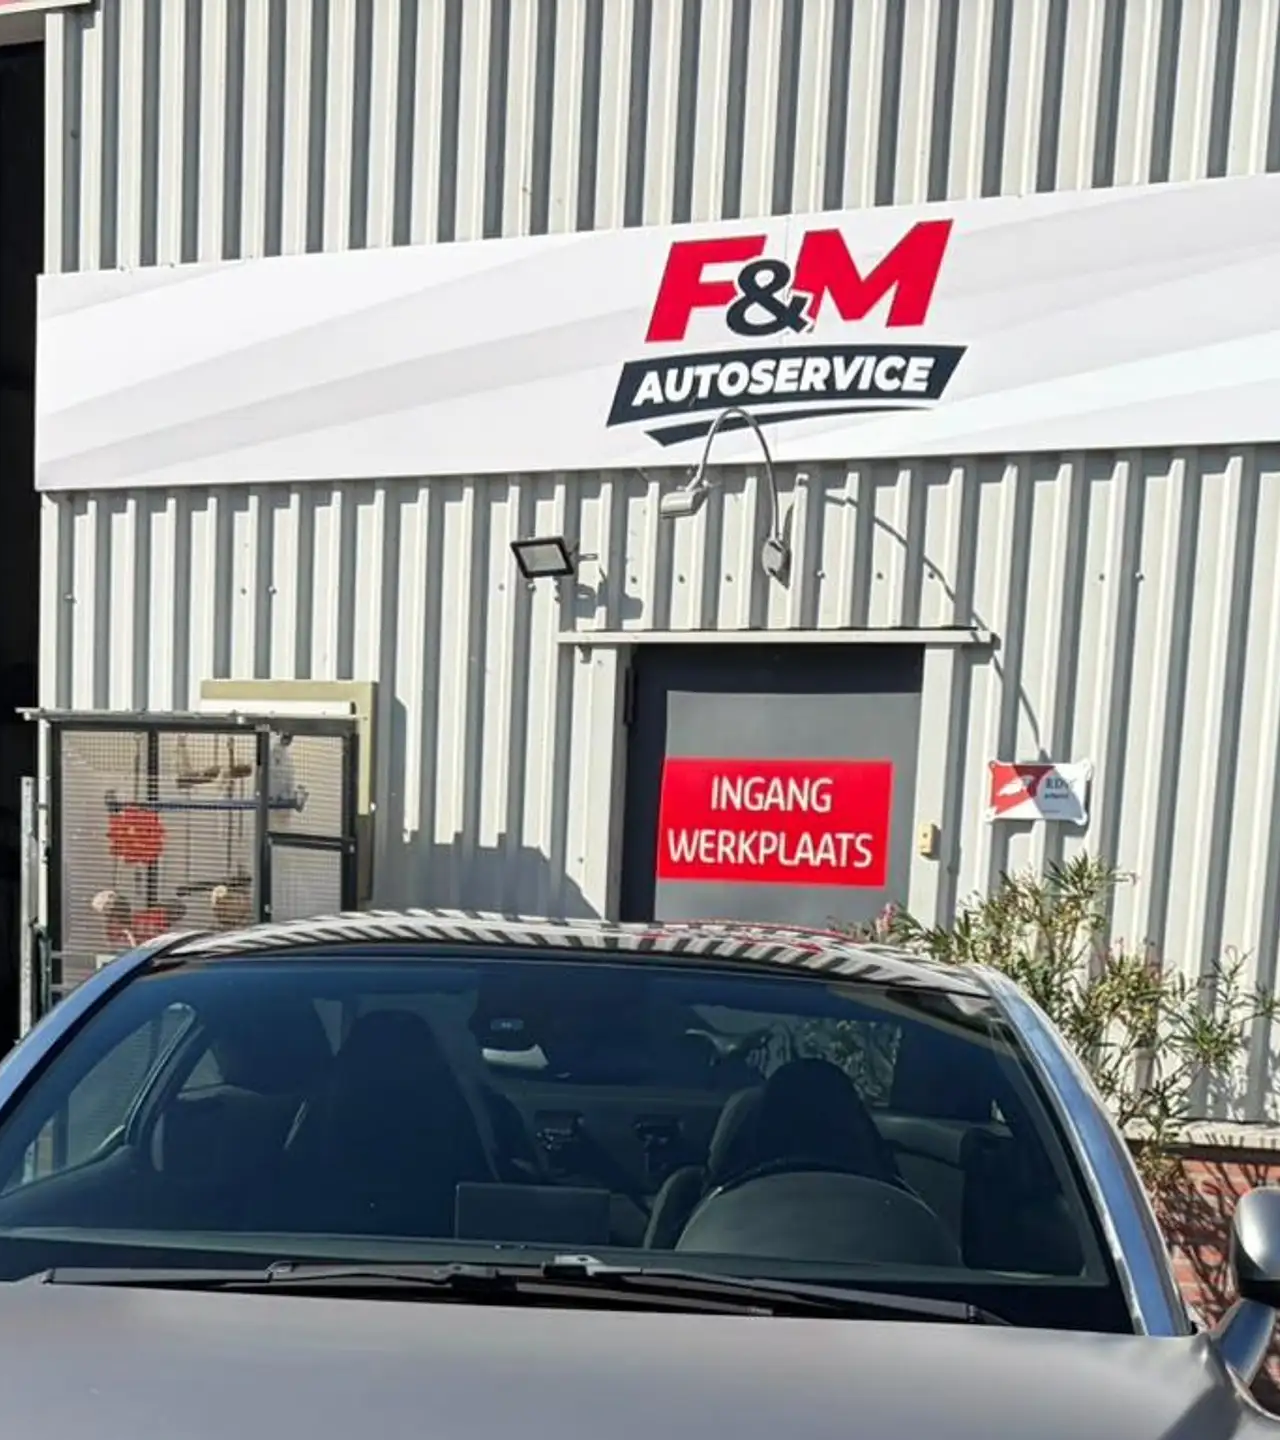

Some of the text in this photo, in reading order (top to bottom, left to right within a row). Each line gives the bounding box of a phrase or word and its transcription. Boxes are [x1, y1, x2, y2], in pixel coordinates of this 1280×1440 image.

[645, 219, 953, 343] F&M
[631, 356, 936, 407] AUTOSERVICE
[711, 775, 833, 813] INGANG
[668, 828, 873, 868] WERKPLAATS
